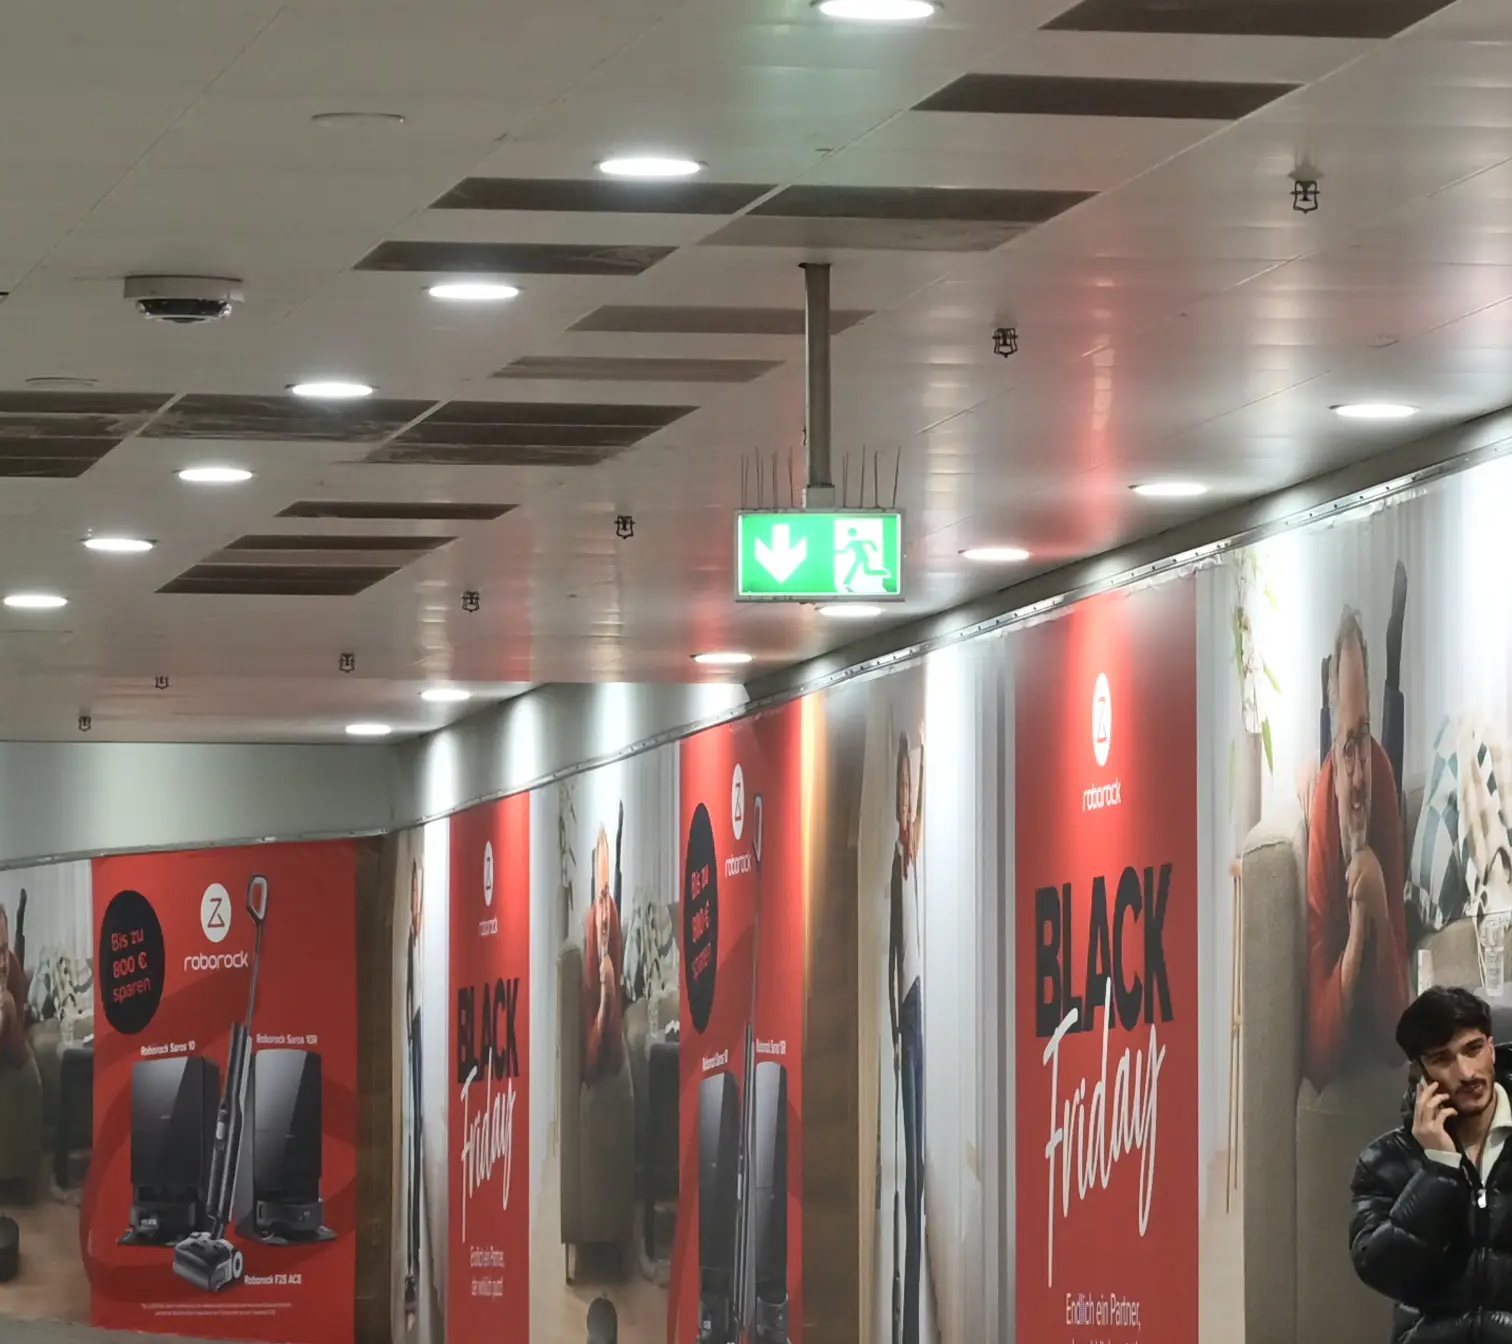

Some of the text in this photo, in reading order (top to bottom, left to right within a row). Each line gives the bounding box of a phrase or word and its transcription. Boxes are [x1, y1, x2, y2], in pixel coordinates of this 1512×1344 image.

[1082, 777, 1122, 813] roborock
[111, 928, 145, 952] Bis zu
[1035, 862, 1175, 1038] BLACK
[112, 951, 148, 979] 800 €
[183, 950, 249, 972] roborock
[112, 976, 152, 1004] sparen
[457, 977, 520, 1084] BLACK
[460, 1046, 516, 1244] Friday
[1042, 976, 1167, 1290] Friday
[1066, 1292, 1141, 1331] Endlich ein Partner,
